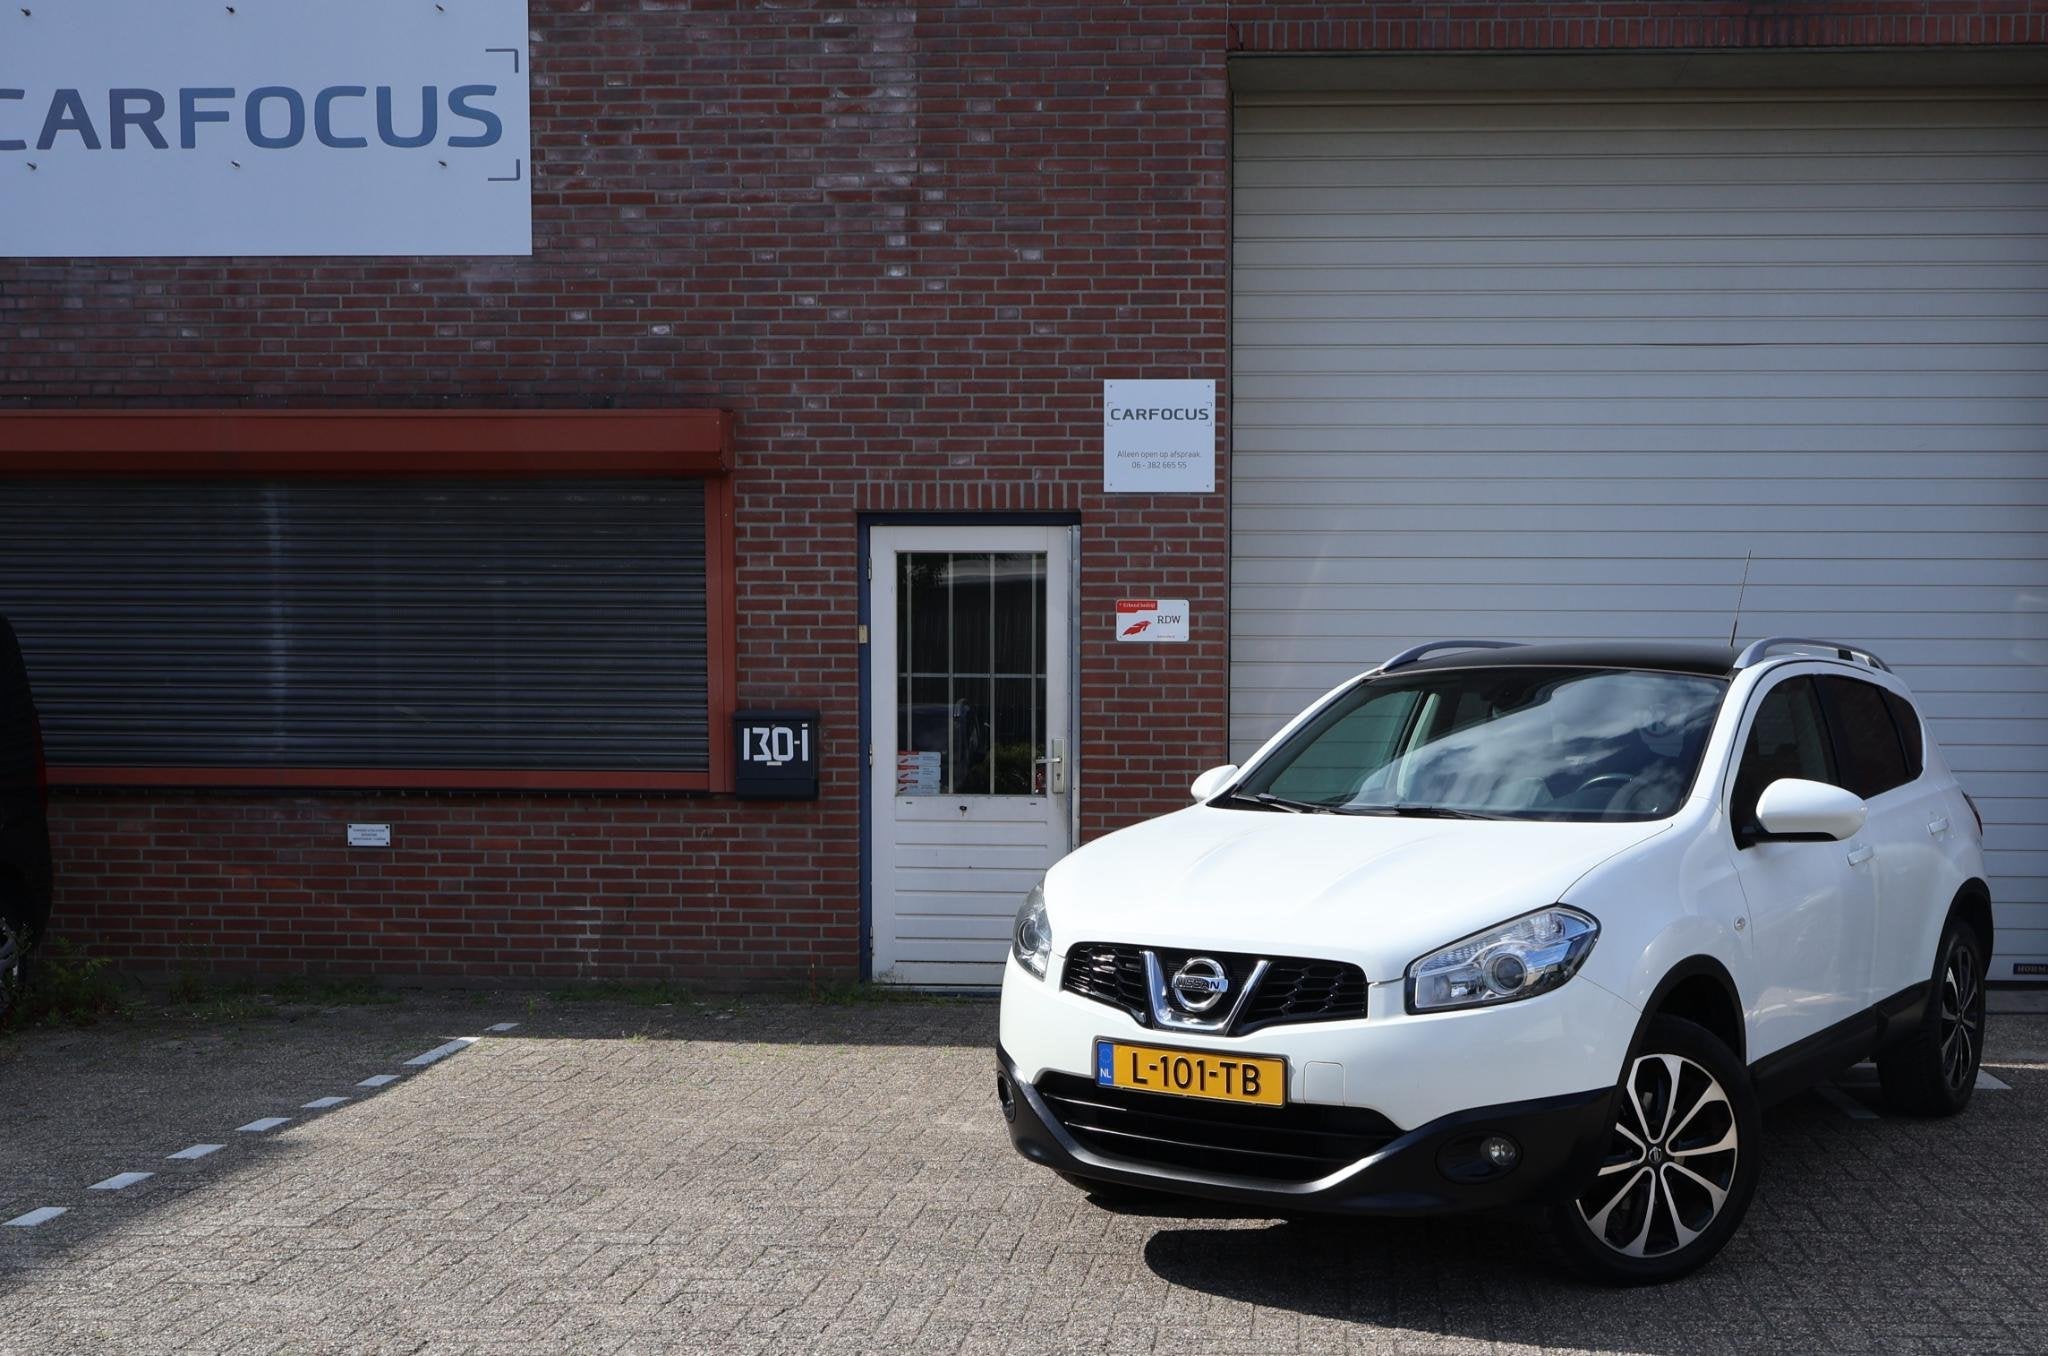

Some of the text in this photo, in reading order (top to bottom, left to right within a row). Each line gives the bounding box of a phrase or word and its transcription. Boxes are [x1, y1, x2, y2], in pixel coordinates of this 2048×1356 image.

[1110, 408, 1209, 420] CARFOCUS
[1117, 450, 1139, 458] Alleen
[1141, 451, 1157, 459] open
[1160, 451, 1168, 459] op
[1157, 615, 1181, 624] RDW
[1176, 977, 1220, 990] NISSAN
[1100, 1068, 1111, 1079] NL
[1132, 1052, 1260, 1096] L-101-TB
